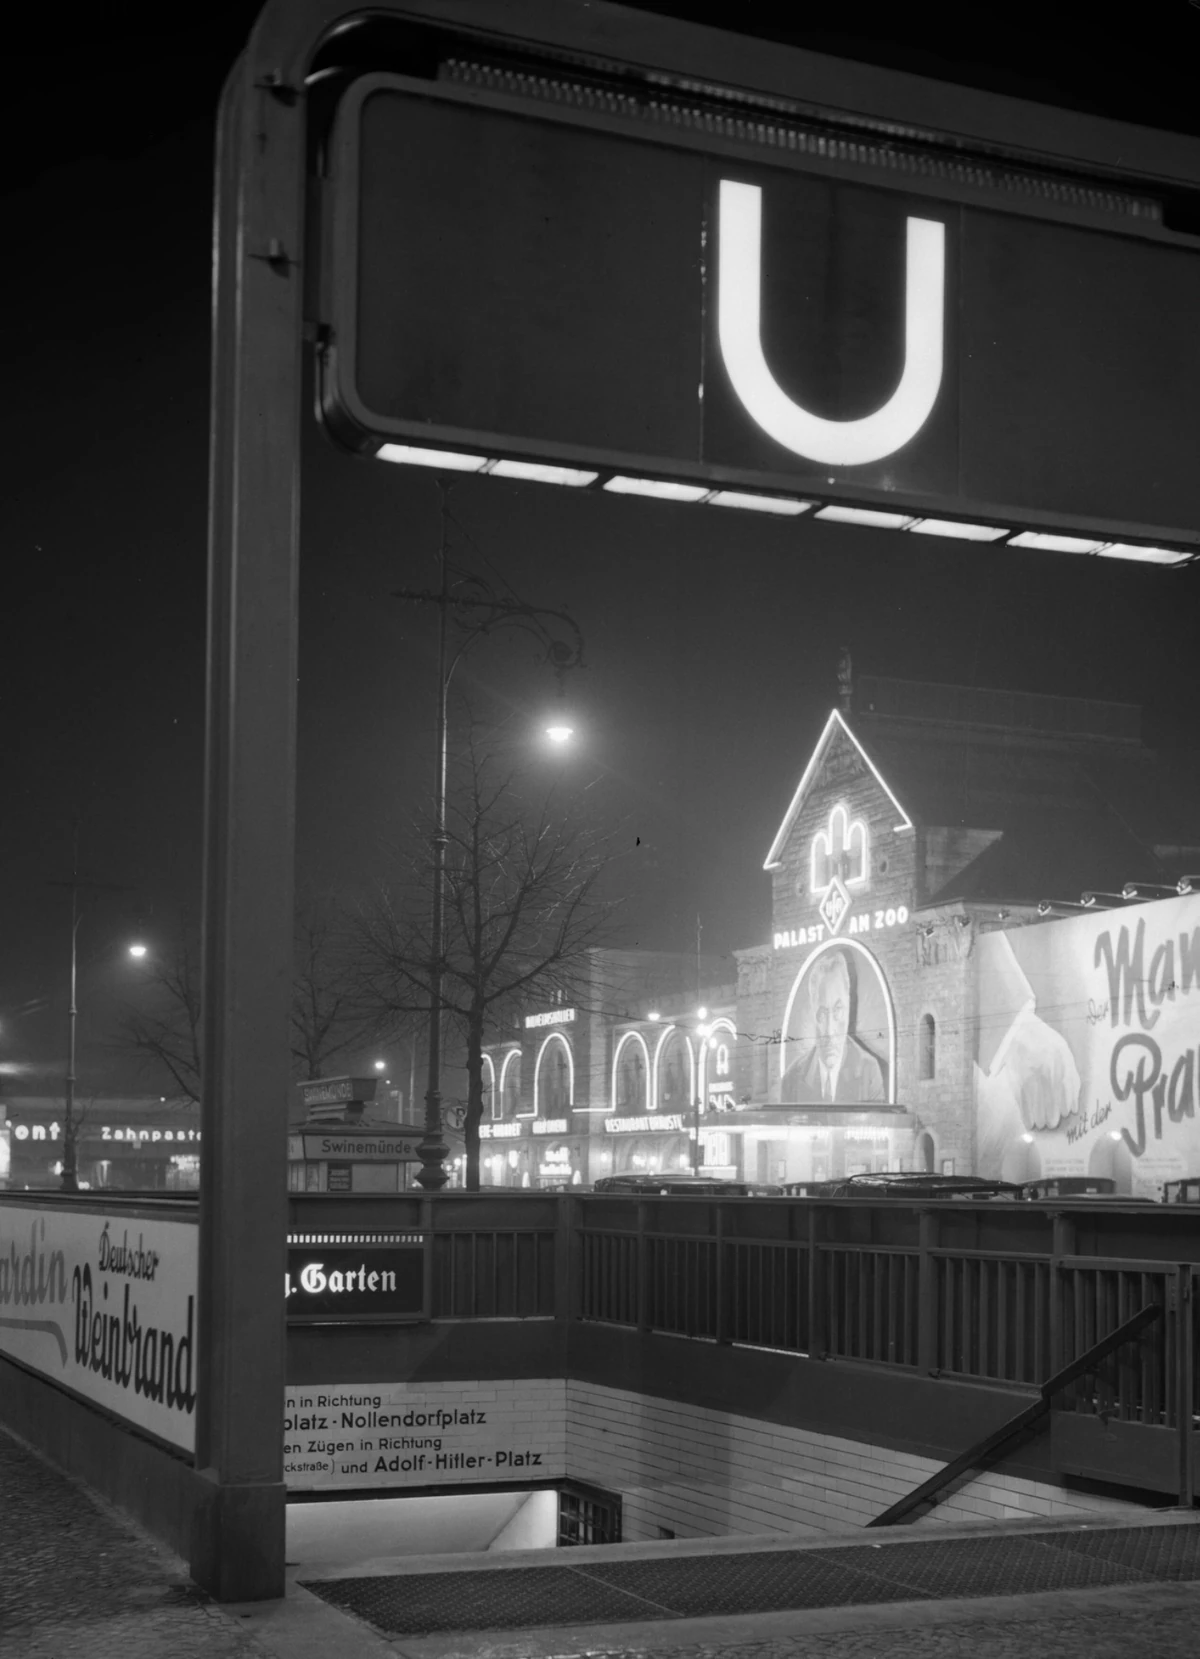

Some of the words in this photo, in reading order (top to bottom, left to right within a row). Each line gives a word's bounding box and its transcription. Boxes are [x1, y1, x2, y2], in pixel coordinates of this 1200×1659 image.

[717, 178, 946, 467] U
[774, 924, 825, 949] PALAST
[849, 914, 870, 933] AM
[874, 905, 909, 929] ZOO
[1066, 1119, 1088, 1145] mit
[1090, 1099, 1111, 1129] der
[1110, 1033, 1200, 1157] Pra
[321, 1138, 411, 1154] Swinemünde
[98, 1220, 159, 1282] Deutscher
[300, 1263, 397, 1294] Garten
[72, 1262, 197, 1415] Weinbrand
[300, 1396, 313, 1408] in
[317, 1394, 382, 1409] Richtung
[341, 1408, 487, 1429] Nollendorfplatz
[307, 1440, 354, 1456] Zügen
[360, 1439, 373, 1451] in
[379, 1436, 442, 1451] Richtung
[341, 1462, 368, 1474] und
